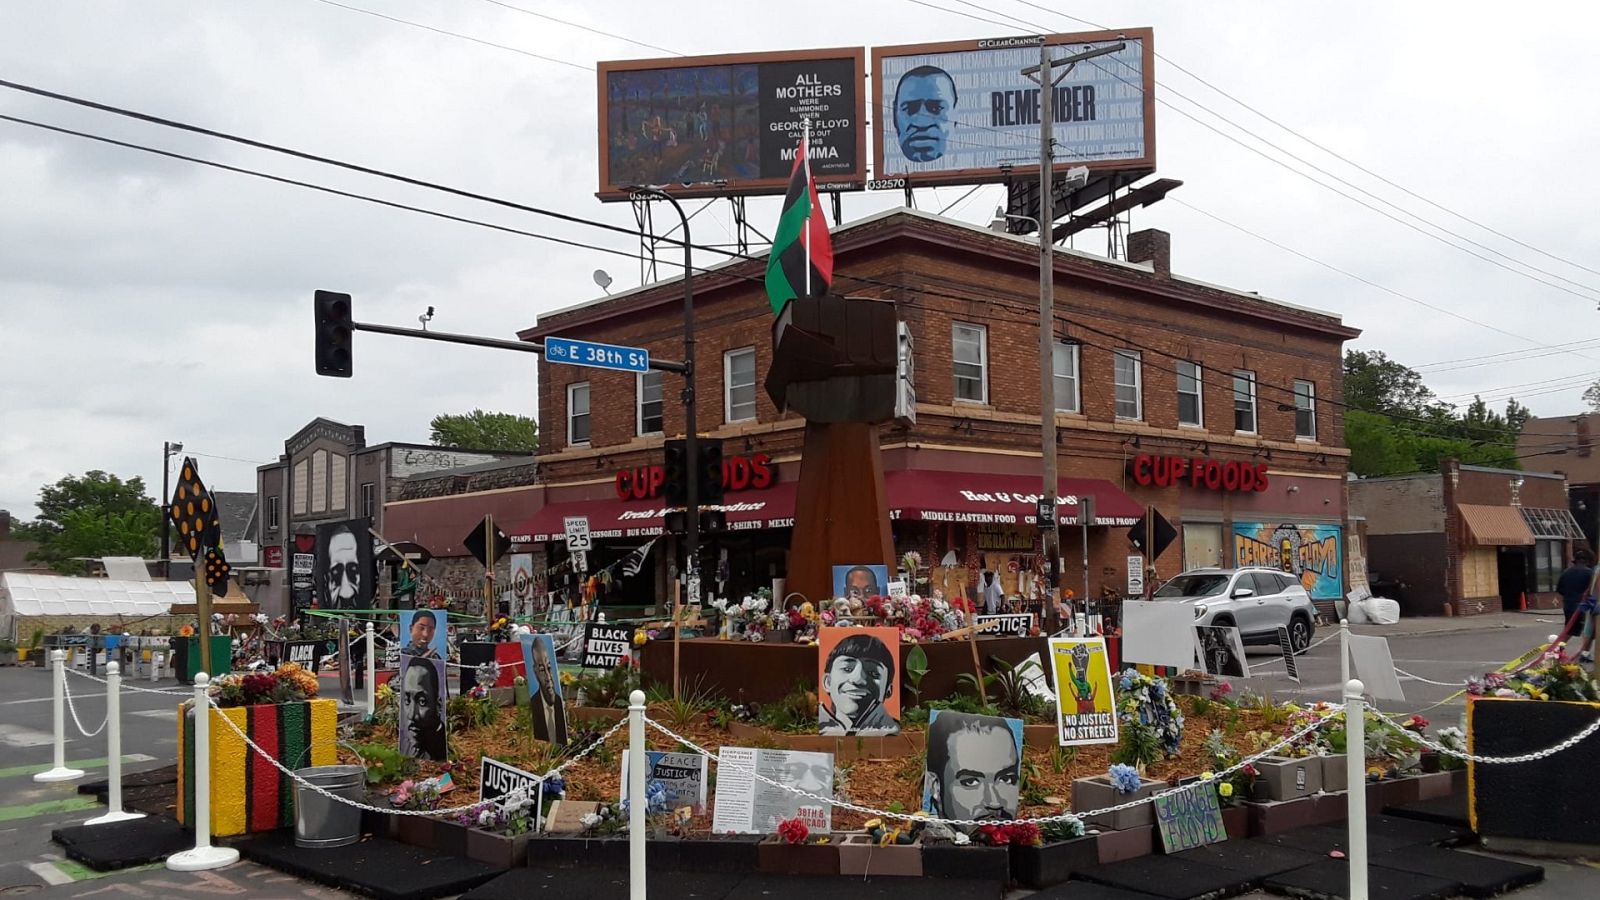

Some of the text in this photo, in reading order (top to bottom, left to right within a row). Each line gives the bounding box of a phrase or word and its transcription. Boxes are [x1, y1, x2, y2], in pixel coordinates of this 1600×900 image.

[796, 74, 821, 85] ALL
[776, 85, 842, 99] MOTHERS
[790, 105, 829, 113] SUMMONED
[816, 119, 849, 128] FLOYD
[868, 179, 905, 190] 032570
[569, 346, 645, 367] E 38th St
[1134, 453, 1269, 492] CUP FOODS
[615, 465, 665, 502] CUP
[960, 490, 996, 502] Hot
[995, 492, 1012, 503] &
[618, 509, 655, 520] Fresh
[921, 511, 954, 521] MIDDLE
[955, 513, 993, 523] EASTERN
[994, 514, 1016, 524] FOOD
[727, 520, 762, 530] T-SHIRTS
[511, 535, 531, 543] STAMPS
[626, 528, 640, 536] BUS
[641, 527, 664, 536] CARDS
[569, 535, 589, 547] 25
[1299, 535, 1337, 579] FLOYD
[592, 628, 629, 641] BLACK
[290, 644, 315, 661] BLACK
[594, 642, 624, 653] LIVES
[585, 655, 622, 667] MATTE
[1065, 712, 1112, 726] NO JUSTICE
[1063, 724, 1115, 740] NO STREETS
[664, 756, 697, 767] PEACE
[1156, 781, 1218, 823] GEORGE
[797, 807, 817, 818] 38TH
[1166, 813, 1219, 850] FLOYD
